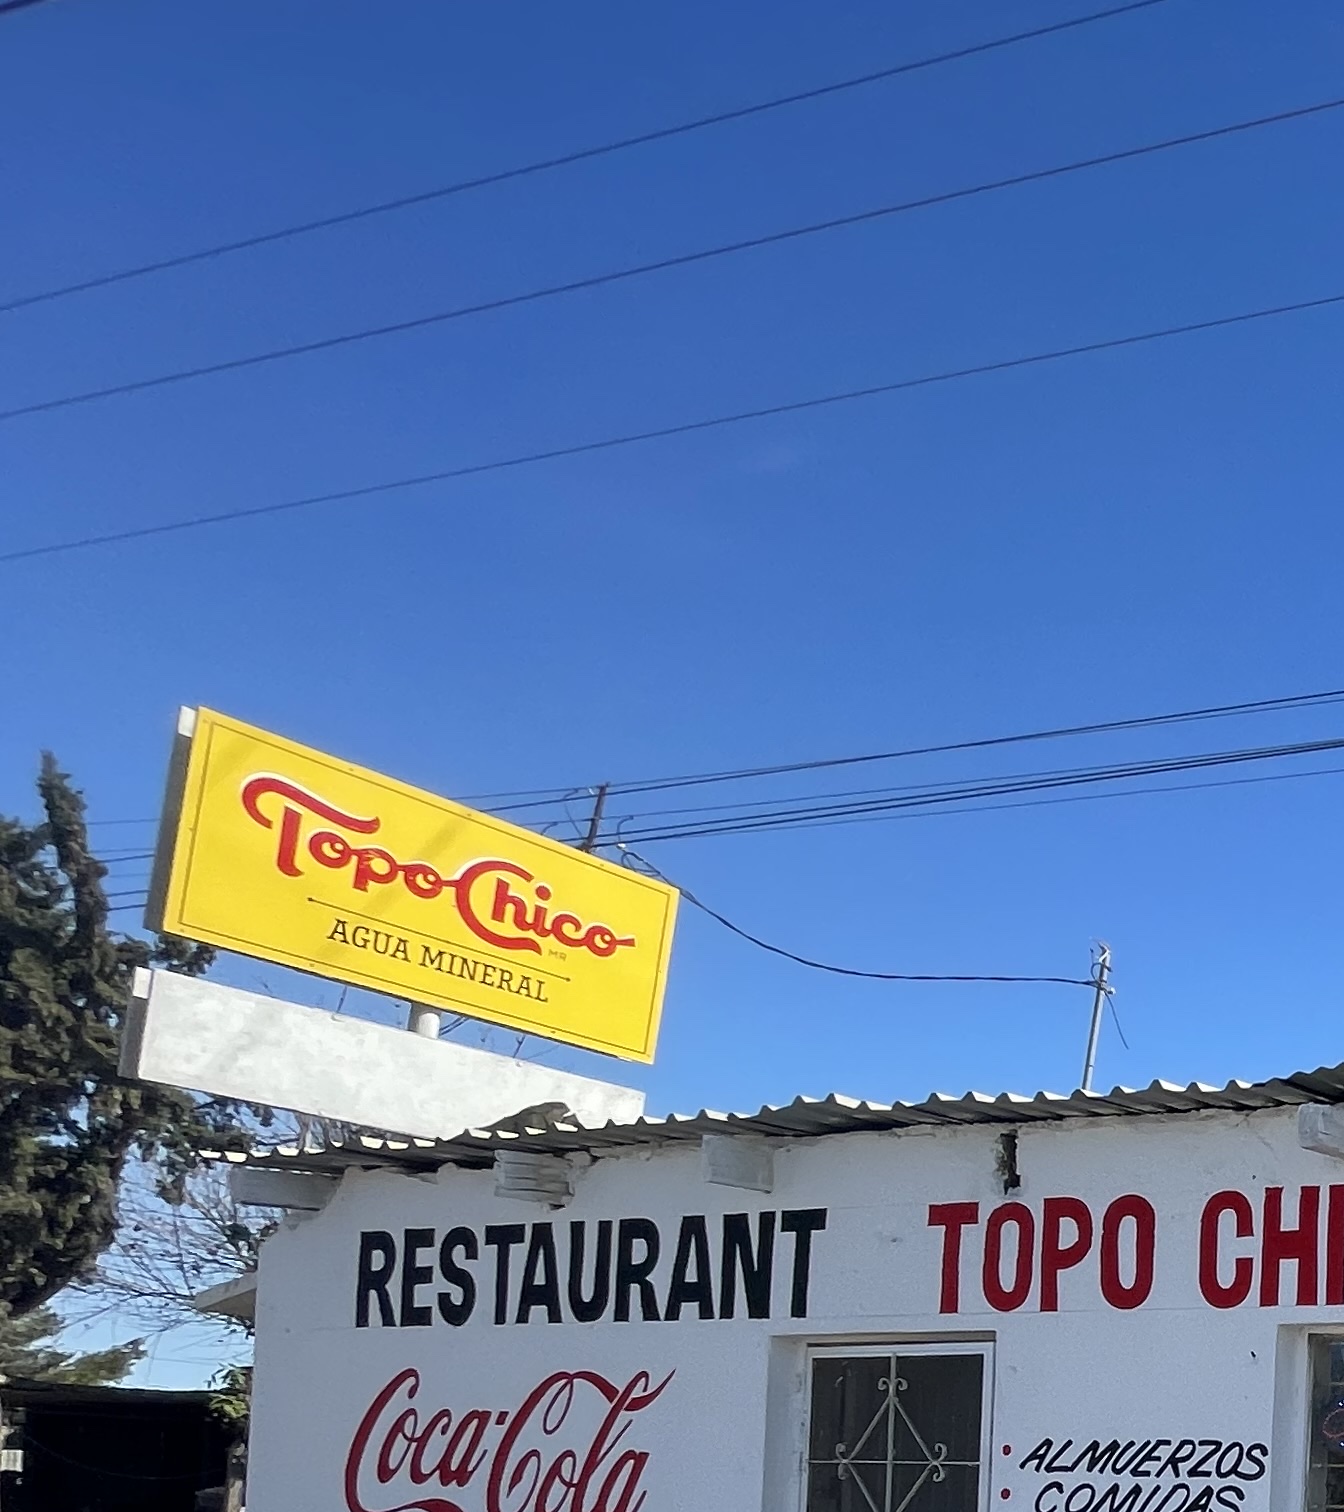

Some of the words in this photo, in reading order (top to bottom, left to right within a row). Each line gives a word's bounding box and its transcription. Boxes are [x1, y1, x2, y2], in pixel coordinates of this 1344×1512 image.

[241, 774, 450, 897] Topo
[448, 860, 636, 957] Chico
[326, 917, 411, 964] AGUA
[418, 944, 549, 1003] MINERAL
[355, 1207, 828, 1328] RESTAURANT
[928, 1193, 1156, 1313] TOPO
[1018, 1437, 1269, 1481] ALMUERZOS
